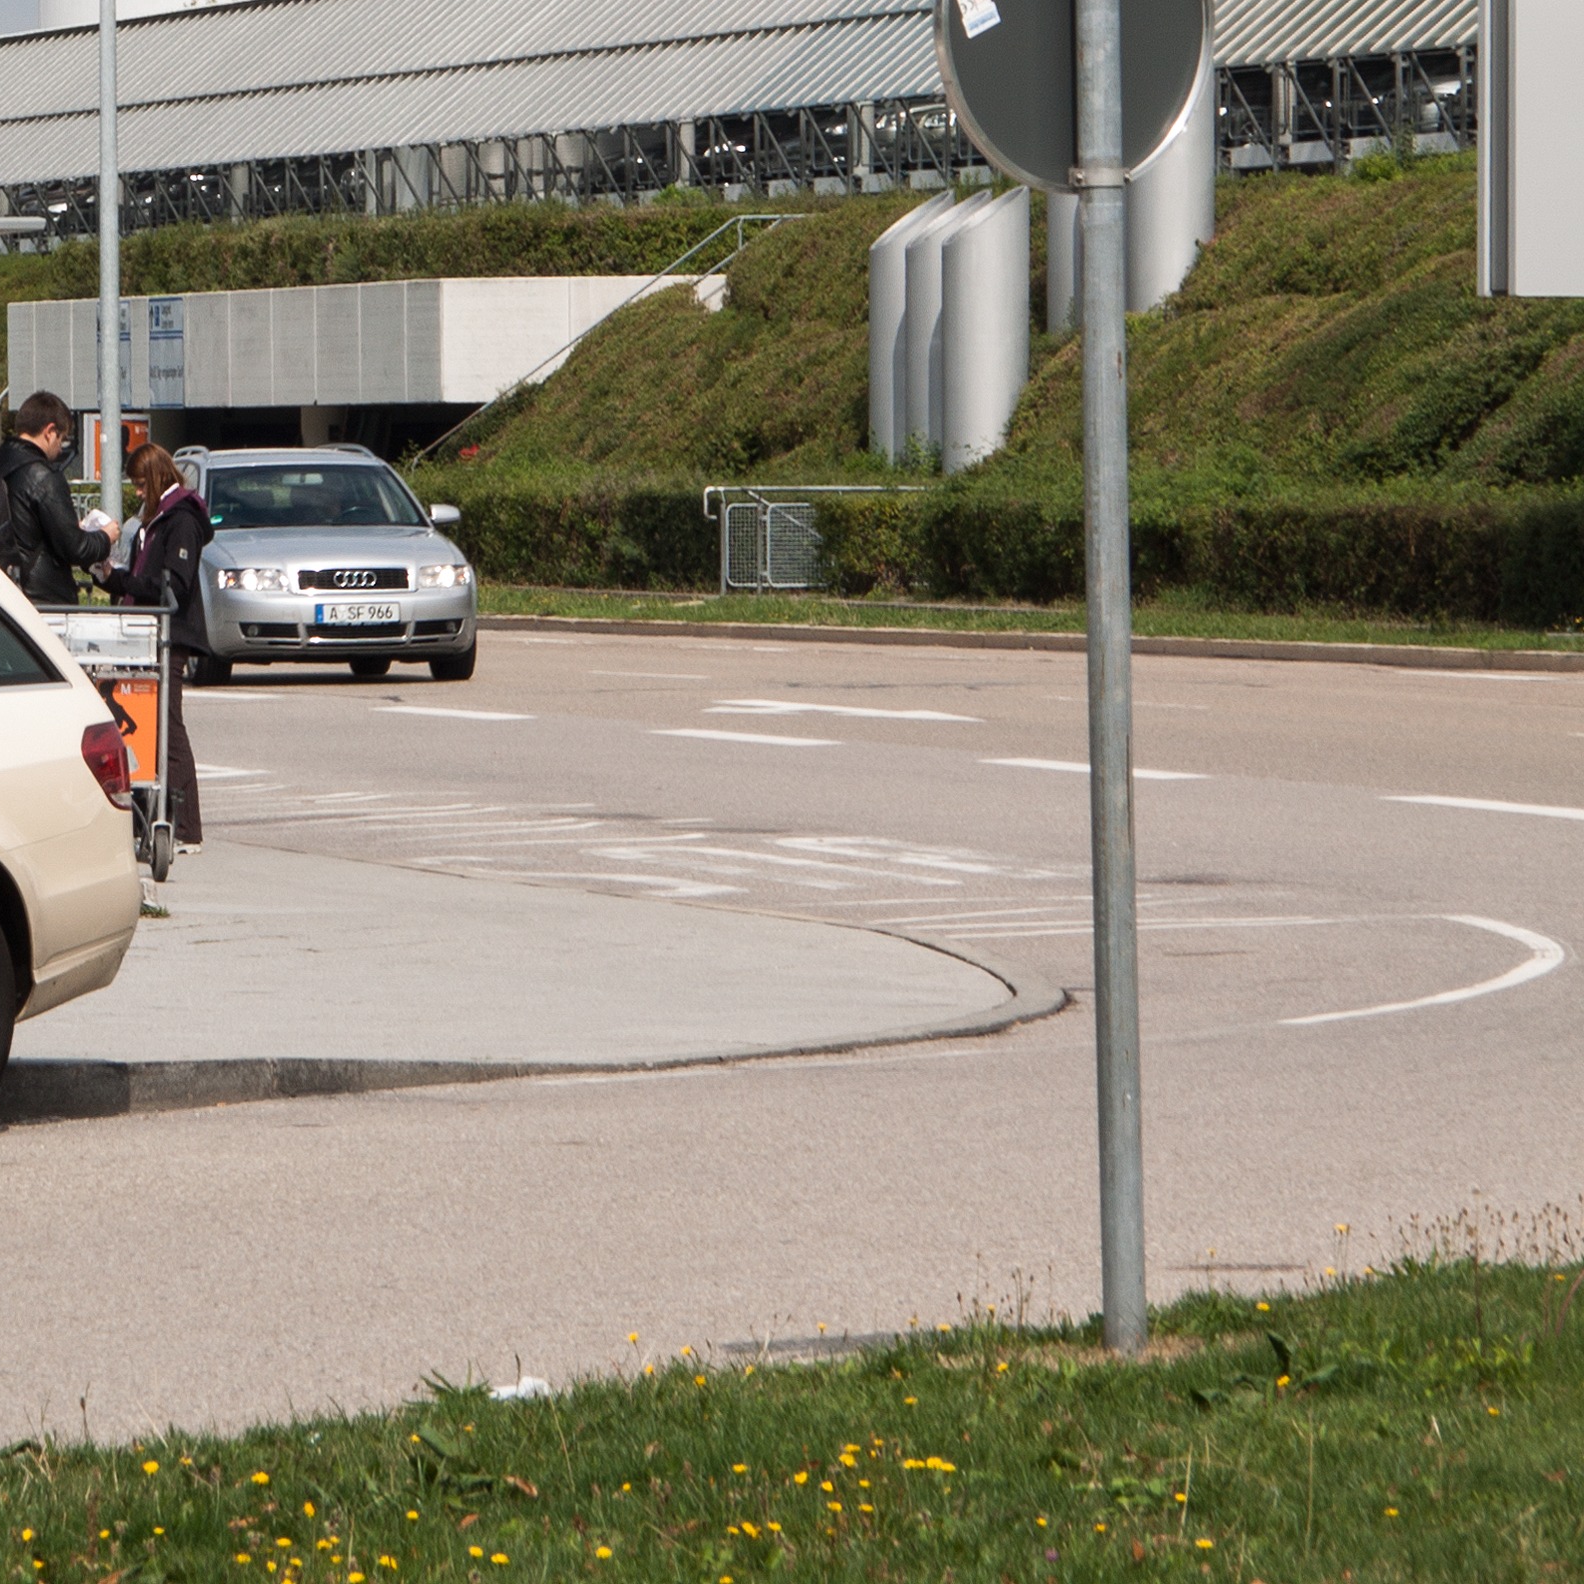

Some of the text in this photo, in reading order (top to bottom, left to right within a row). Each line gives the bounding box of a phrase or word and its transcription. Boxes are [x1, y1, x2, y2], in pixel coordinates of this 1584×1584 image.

[329, 605, 393, 620] A SF 966
